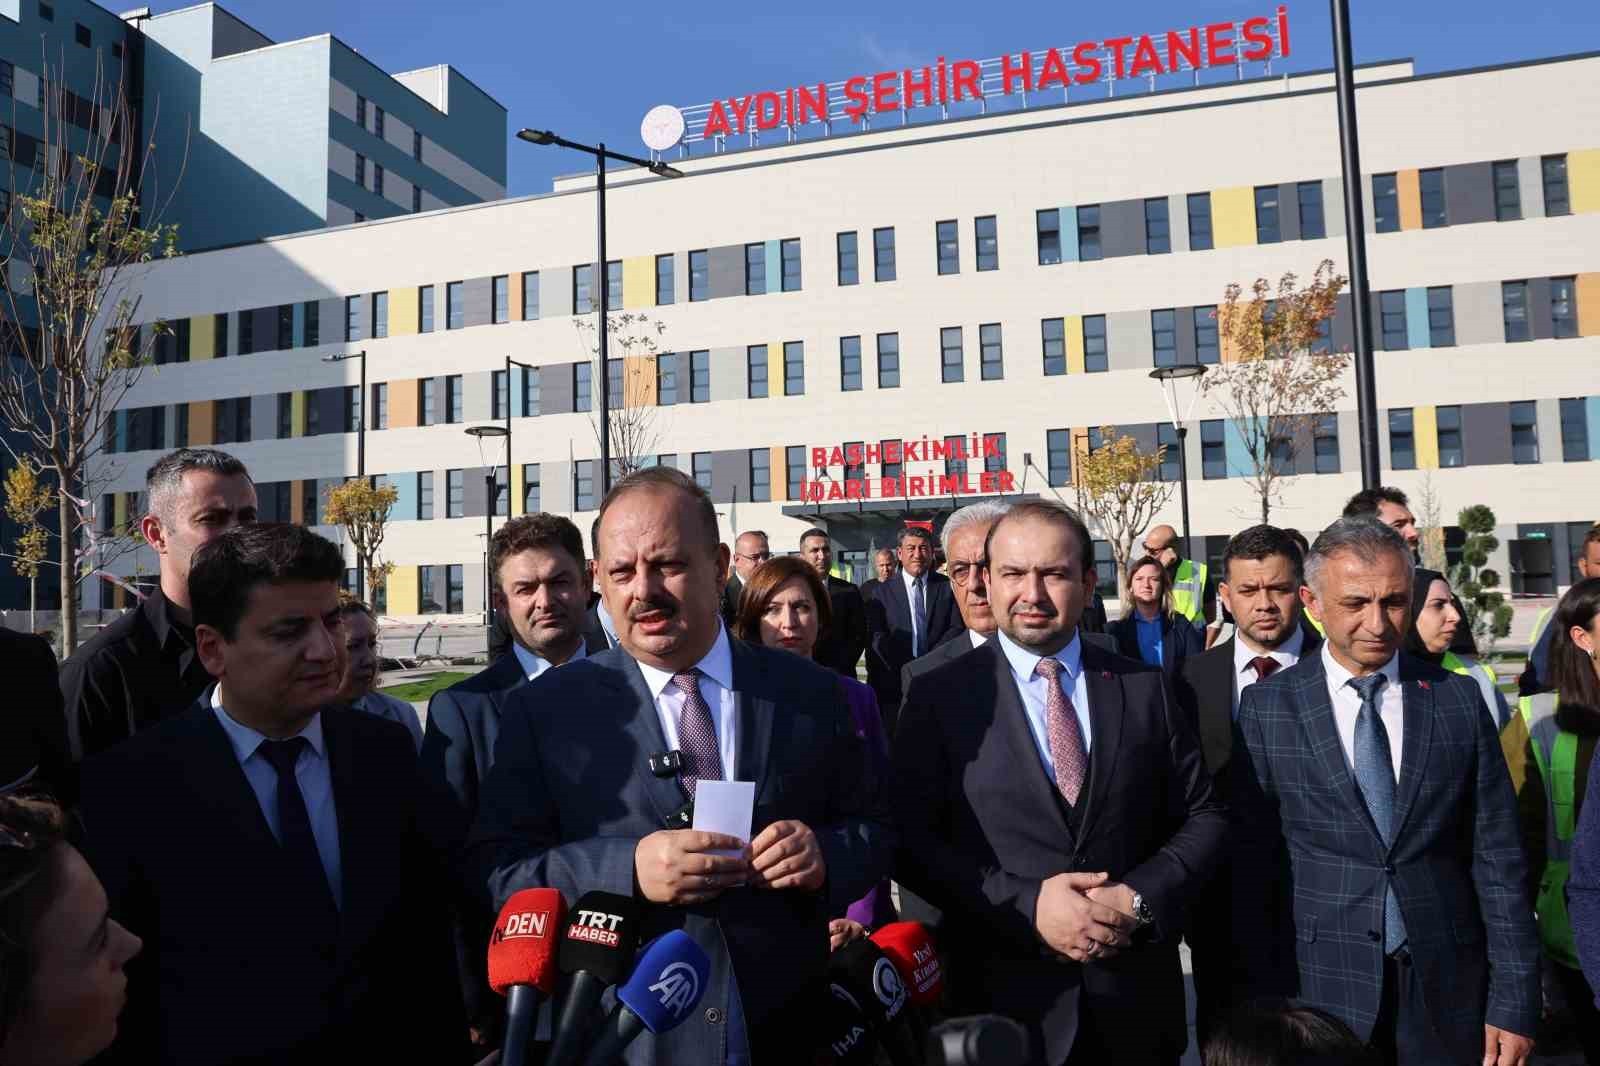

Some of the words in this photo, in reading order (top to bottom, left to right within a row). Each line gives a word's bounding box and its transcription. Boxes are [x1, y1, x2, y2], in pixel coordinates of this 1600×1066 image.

[702, 84, 827, 138] AYDIN
[843, 57, 981, 123] ŞEHİR
[1002, 6, 1290, 94] HASTANESİ
[812, 432, 1000, 471] BAŞHEKİMLİK
[800, 472, 871, 501] İDARİ
[880, 469, 1015, 498] BİRİMLER
[570, 925, 618, 945] HABER
[577, 910, 623, 931] TRT
